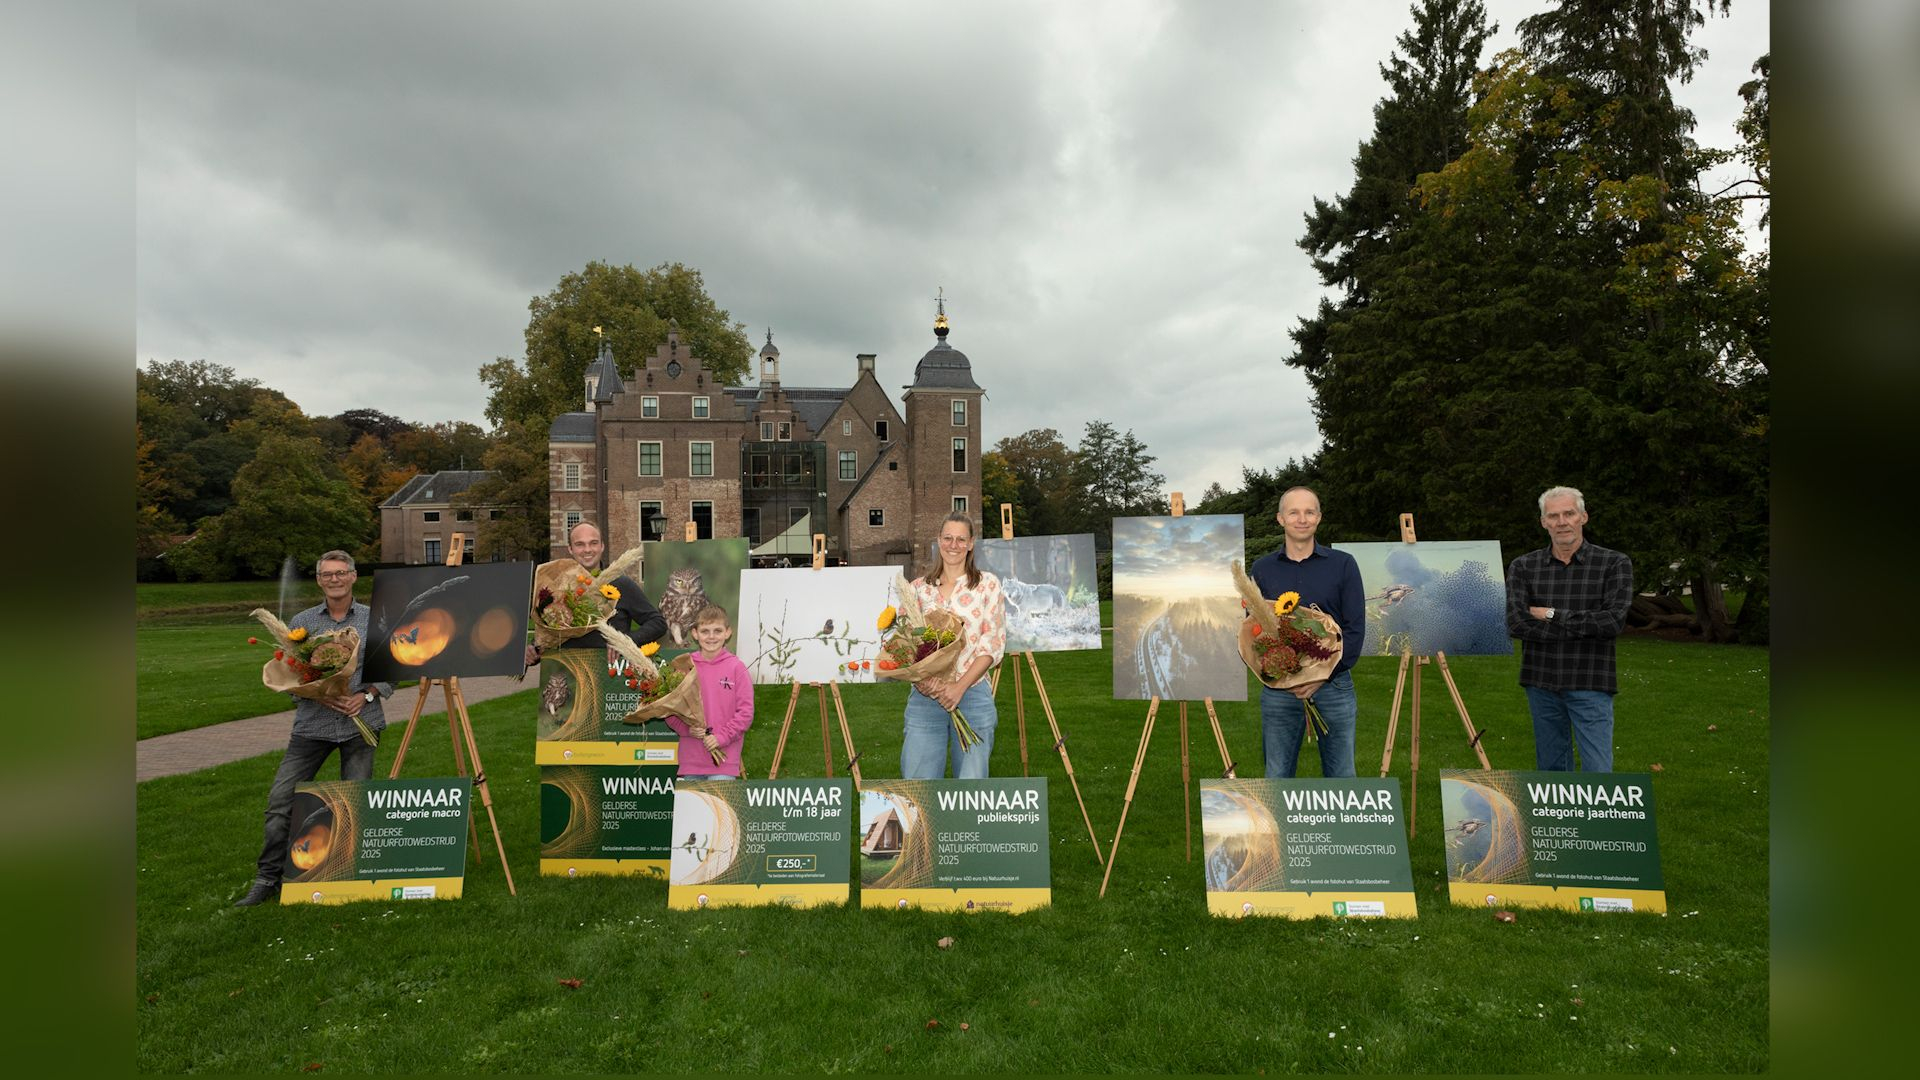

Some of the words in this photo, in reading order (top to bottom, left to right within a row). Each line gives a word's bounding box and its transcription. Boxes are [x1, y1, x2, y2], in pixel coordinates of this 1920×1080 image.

[605, 712, 623, 720] 2025
[602, 777, 676, 795] WINNAA
[367, 788, 462, 809] WINNAAR
[746, 787, 842, 807] WINNAAR
[937, 789, 1040, 811] WINNAAR
[1282, 789, 1393, 811] WINNAAR
[1527, 783, 1644, 807] WINNAAR
[602, 801, 638, 810] GELDERSE
[386, 809, 430, 821] categorie
[431, 809, 461, 818] macro
[783, 807, 803, 818] t/m
[806, 807, 818, 818] 18
[820, 807, 842, 820] jaar
[977, 812, 1040, 824] publieksprijs
[1287, 813, 1336, 825] categorie
[1340, 813, 1395, 825] landschap
[1532, 807, 1585, 820] categorie
[1587, 807, 1646, 820] jaarthema
[602, 821, 620, 830] 2025
[747, 822, 787, 832] GELDERSE
[363, 828, 403, 838] GELDERSE
[746, 832, 841, 842] NATUURFOTOWEDSTRIJD
[938, 832, 980, 842] GELDERSE
[1531, 827, 1579, 837] GELDERSE
[362, 837, 457, 848] NATUURFOTOWEDSTRIJD
[1287, 833, 1332, 843] GELDERSE
[745, 844, 766, 854] 2025
[938, 843, 1039, 854] NATUURFOTOWEDSTRIJD
[1287, 844, 1397, 855] NATUURFOTOWEDSTRIJD
[1532, 839, 1647, 852] NATUURFOTOWEDSTRIJD
[361, 849, 381, 859] 2025
[1534, 851, 1557, 861] 2025
[938, 855, 960, 866] 2025
[1289, 857, 1311, 867] 2025
